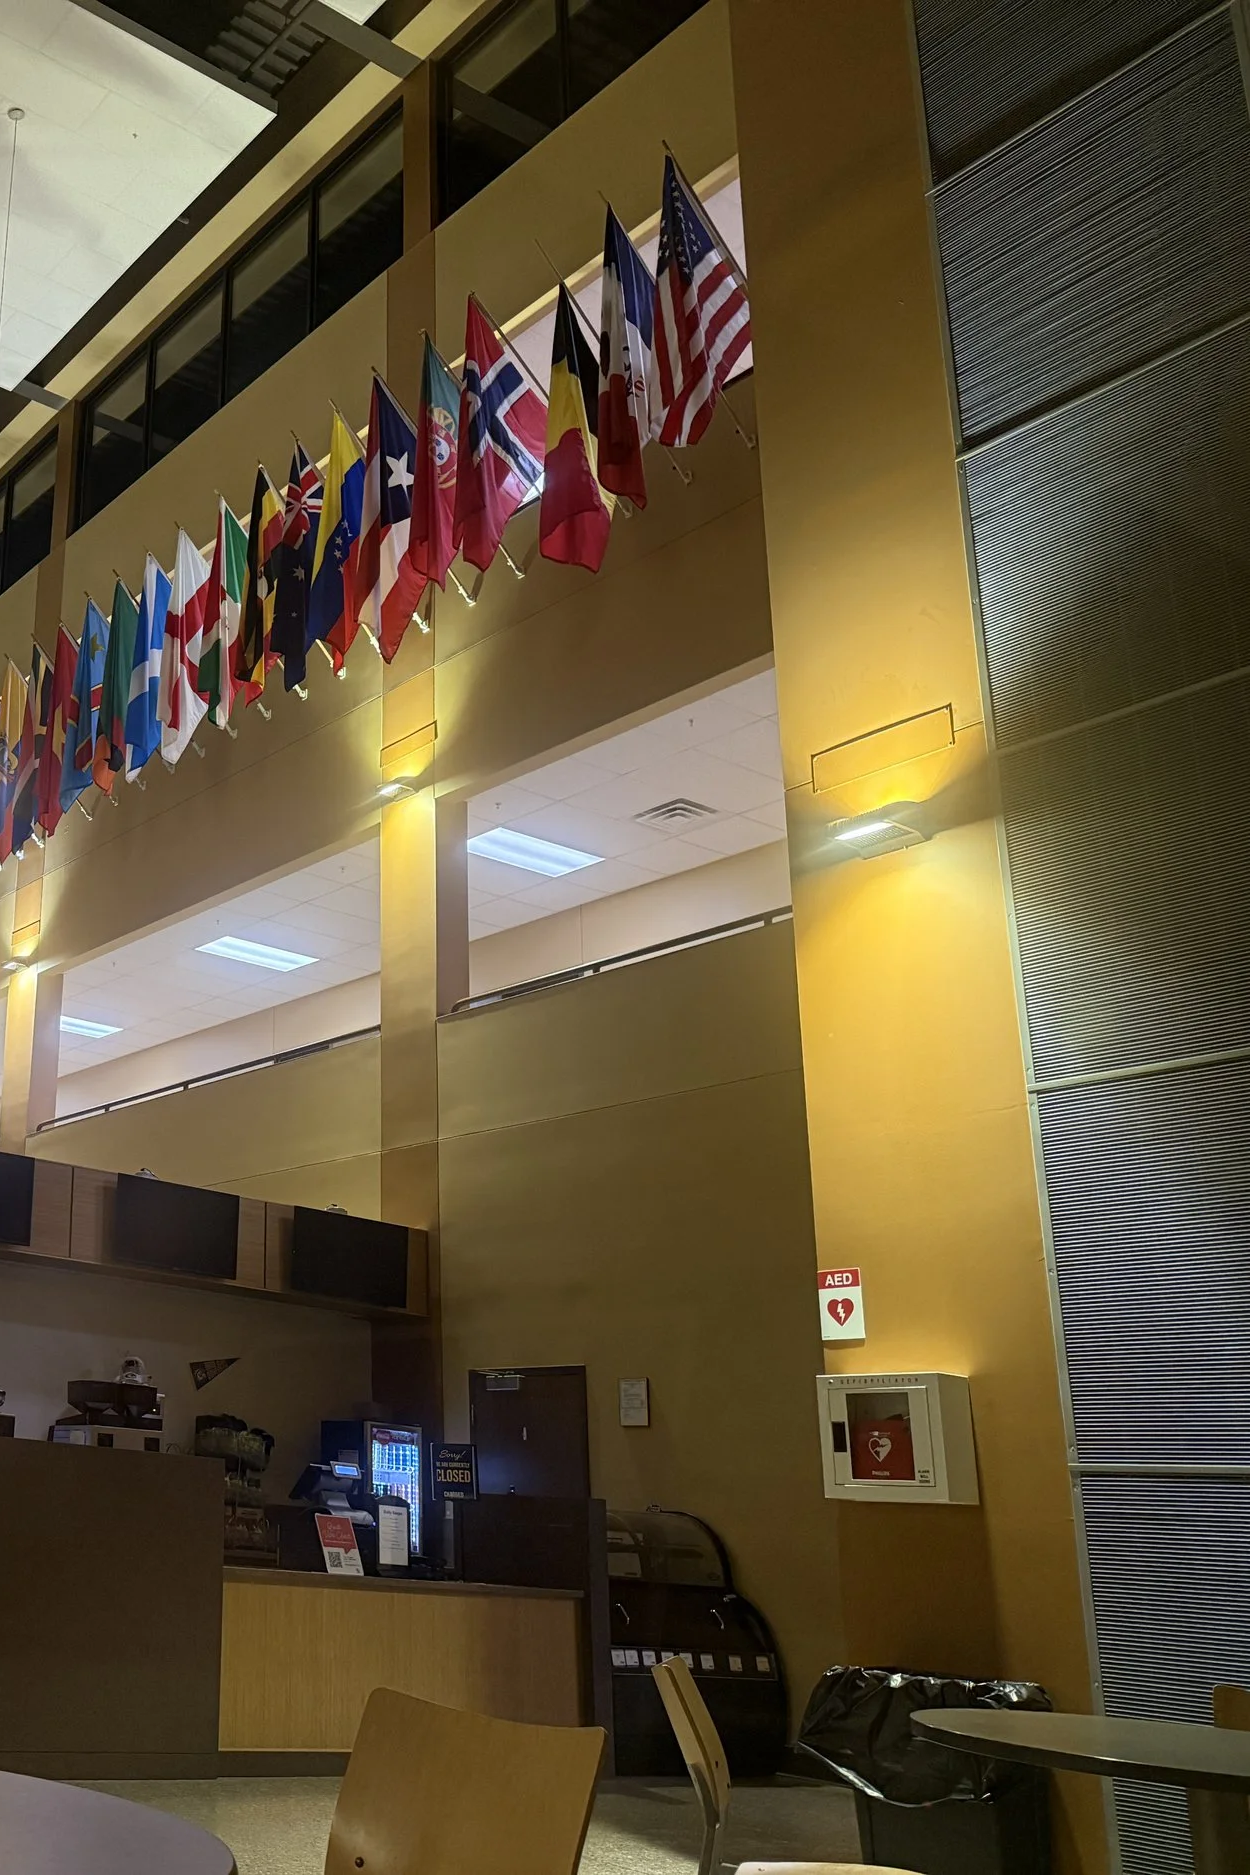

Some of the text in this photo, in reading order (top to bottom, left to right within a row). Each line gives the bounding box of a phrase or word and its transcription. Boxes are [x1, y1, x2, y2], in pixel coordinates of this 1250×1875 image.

[825, 1272, 853, 1287] AED
[439, 1450, 466, 1460] Sorry!
[436, 1469, 471, 1483] CLOSED
